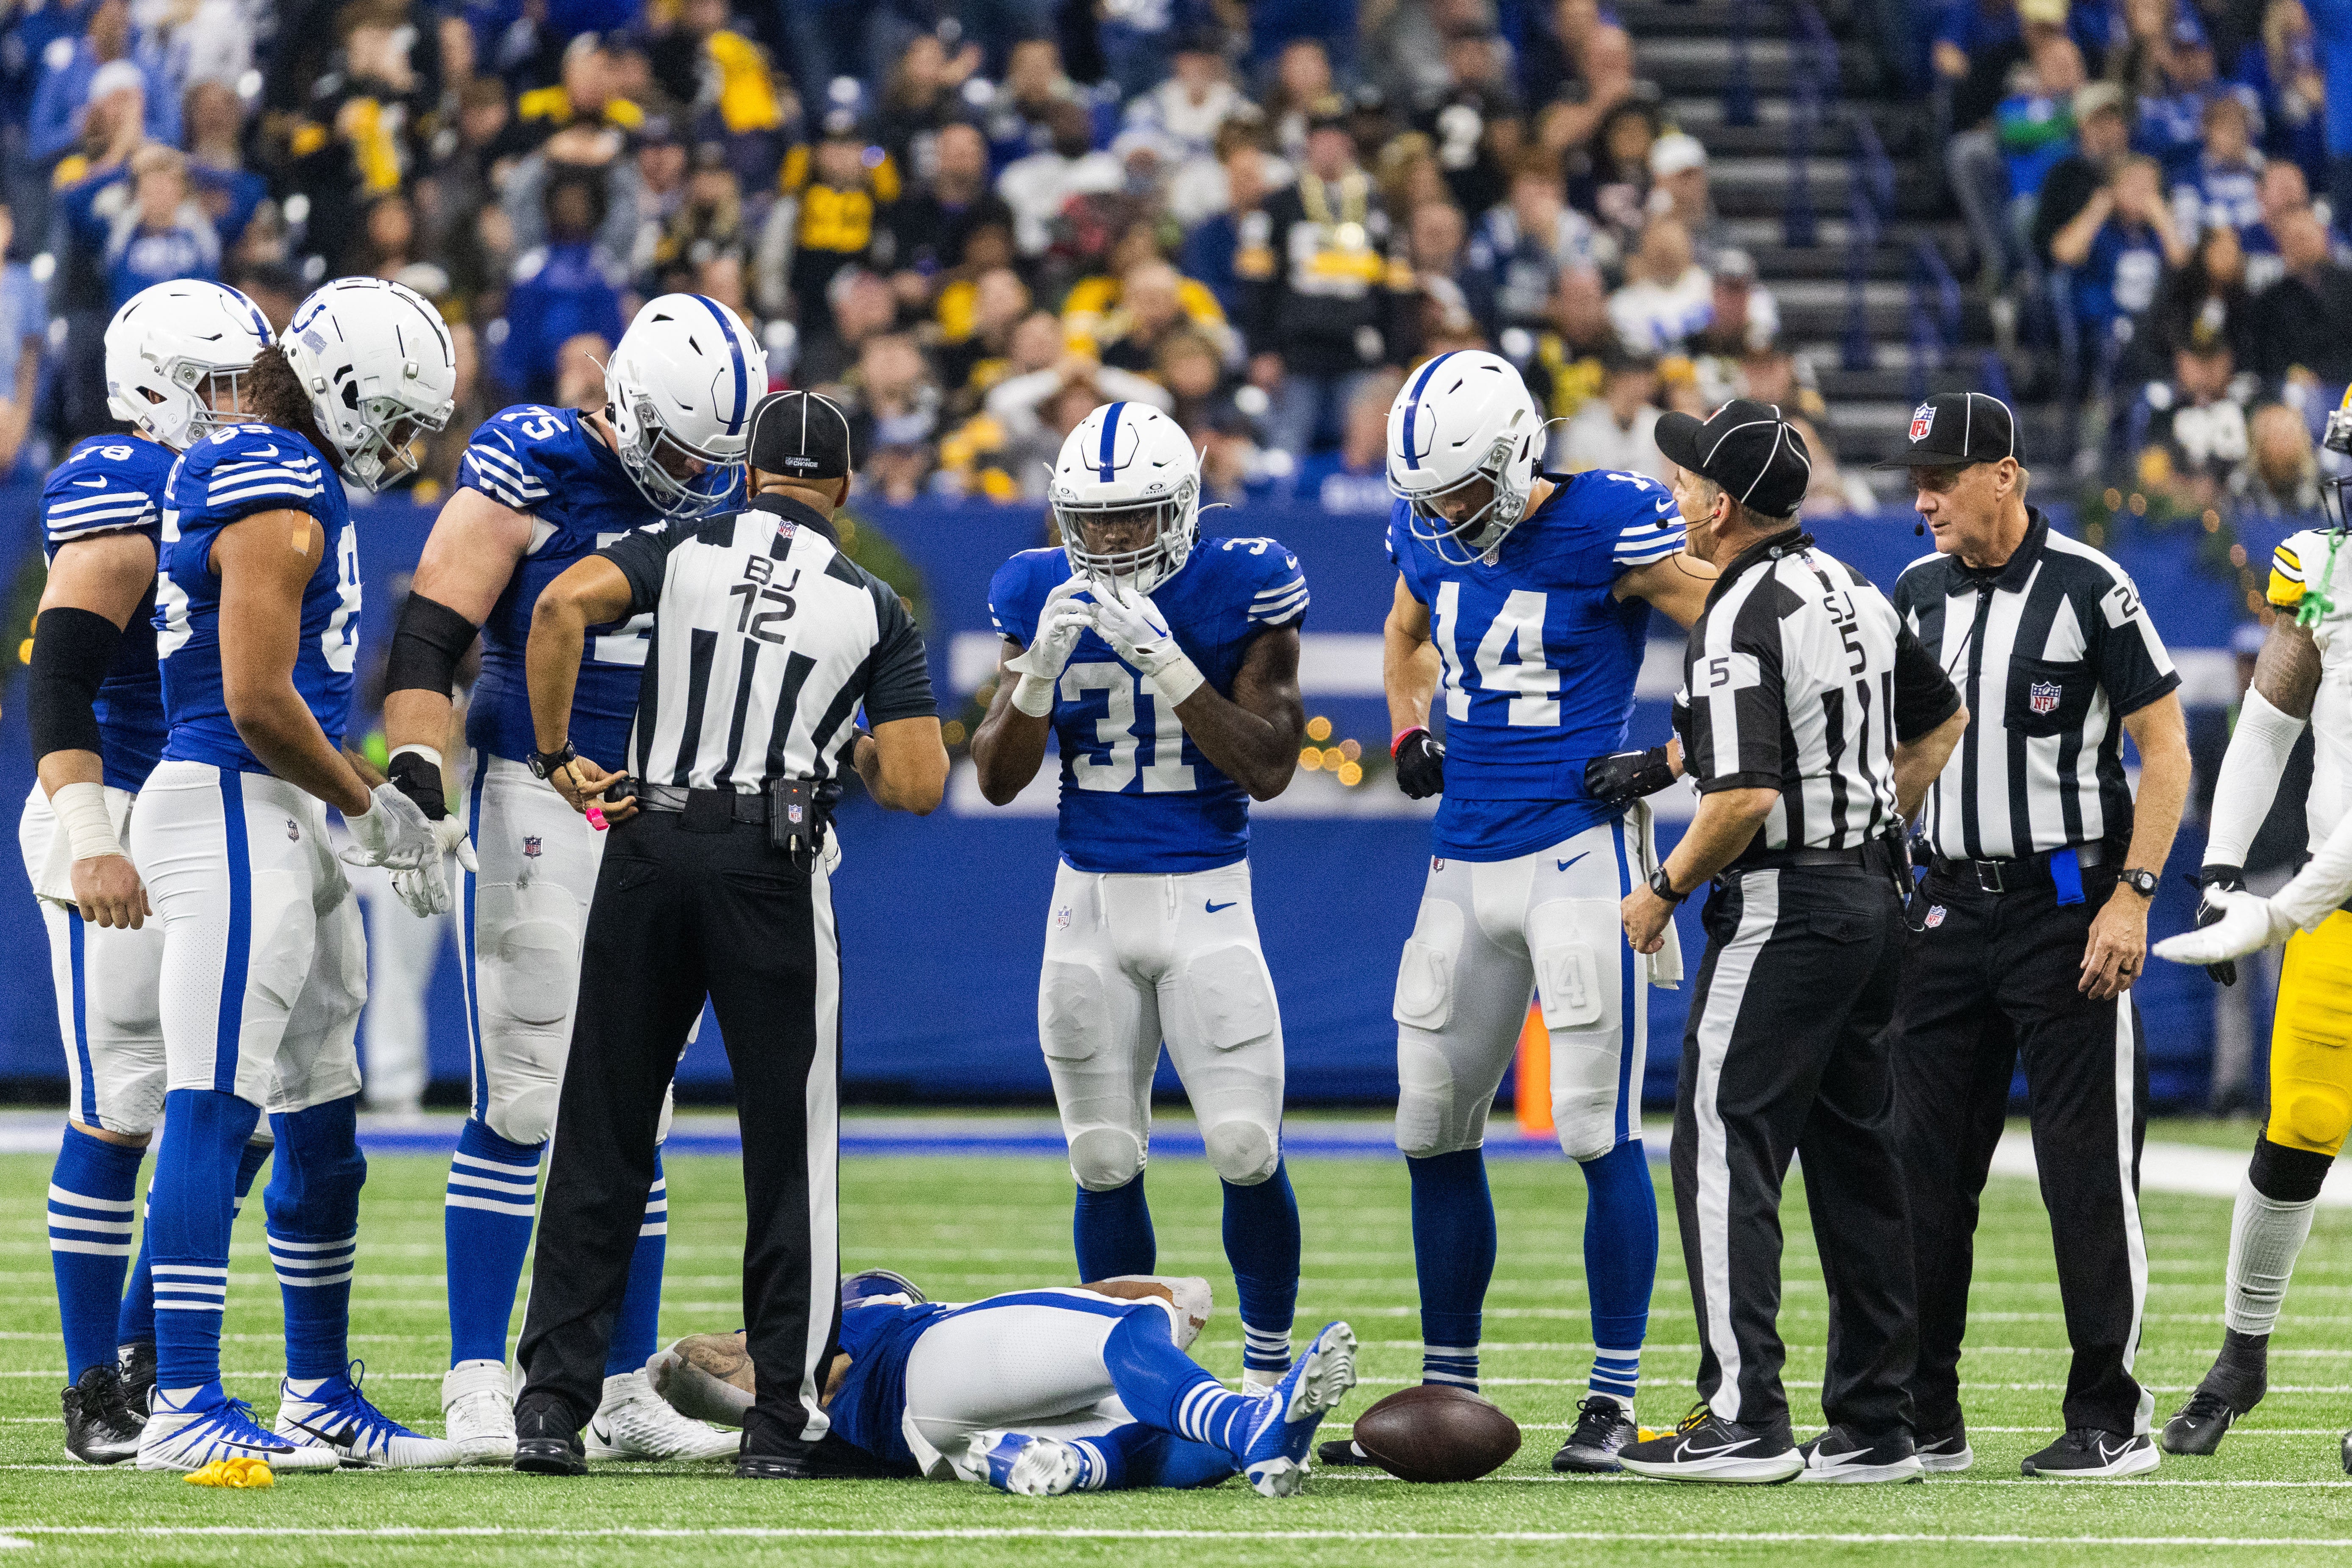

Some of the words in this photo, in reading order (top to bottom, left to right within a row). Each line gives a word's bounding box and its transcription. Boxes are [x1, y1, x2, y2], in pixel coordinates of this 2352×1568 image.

[500, 406, 569, 440] 75
[69, 445, 134, 464] 78
[779, 526, 792, 537] NFL
[744, 555, 800, 592] BJ
[730, 583, 796, 644] 12
[1824, 591, 1855, 625] SJ
[1436, 582, 1560, 726] 14
[1839, 622, 1867, 676] 5
[1710, 657, 1730, 688] 5
[2034, 697, 2057, 711] NFL
[1060, 662, 1197, 792] 31
[526, 845, 539, 853] NFL
[1058, 917, 1066, 925] NFL
[1927, 915, 1940, 924] NFL
